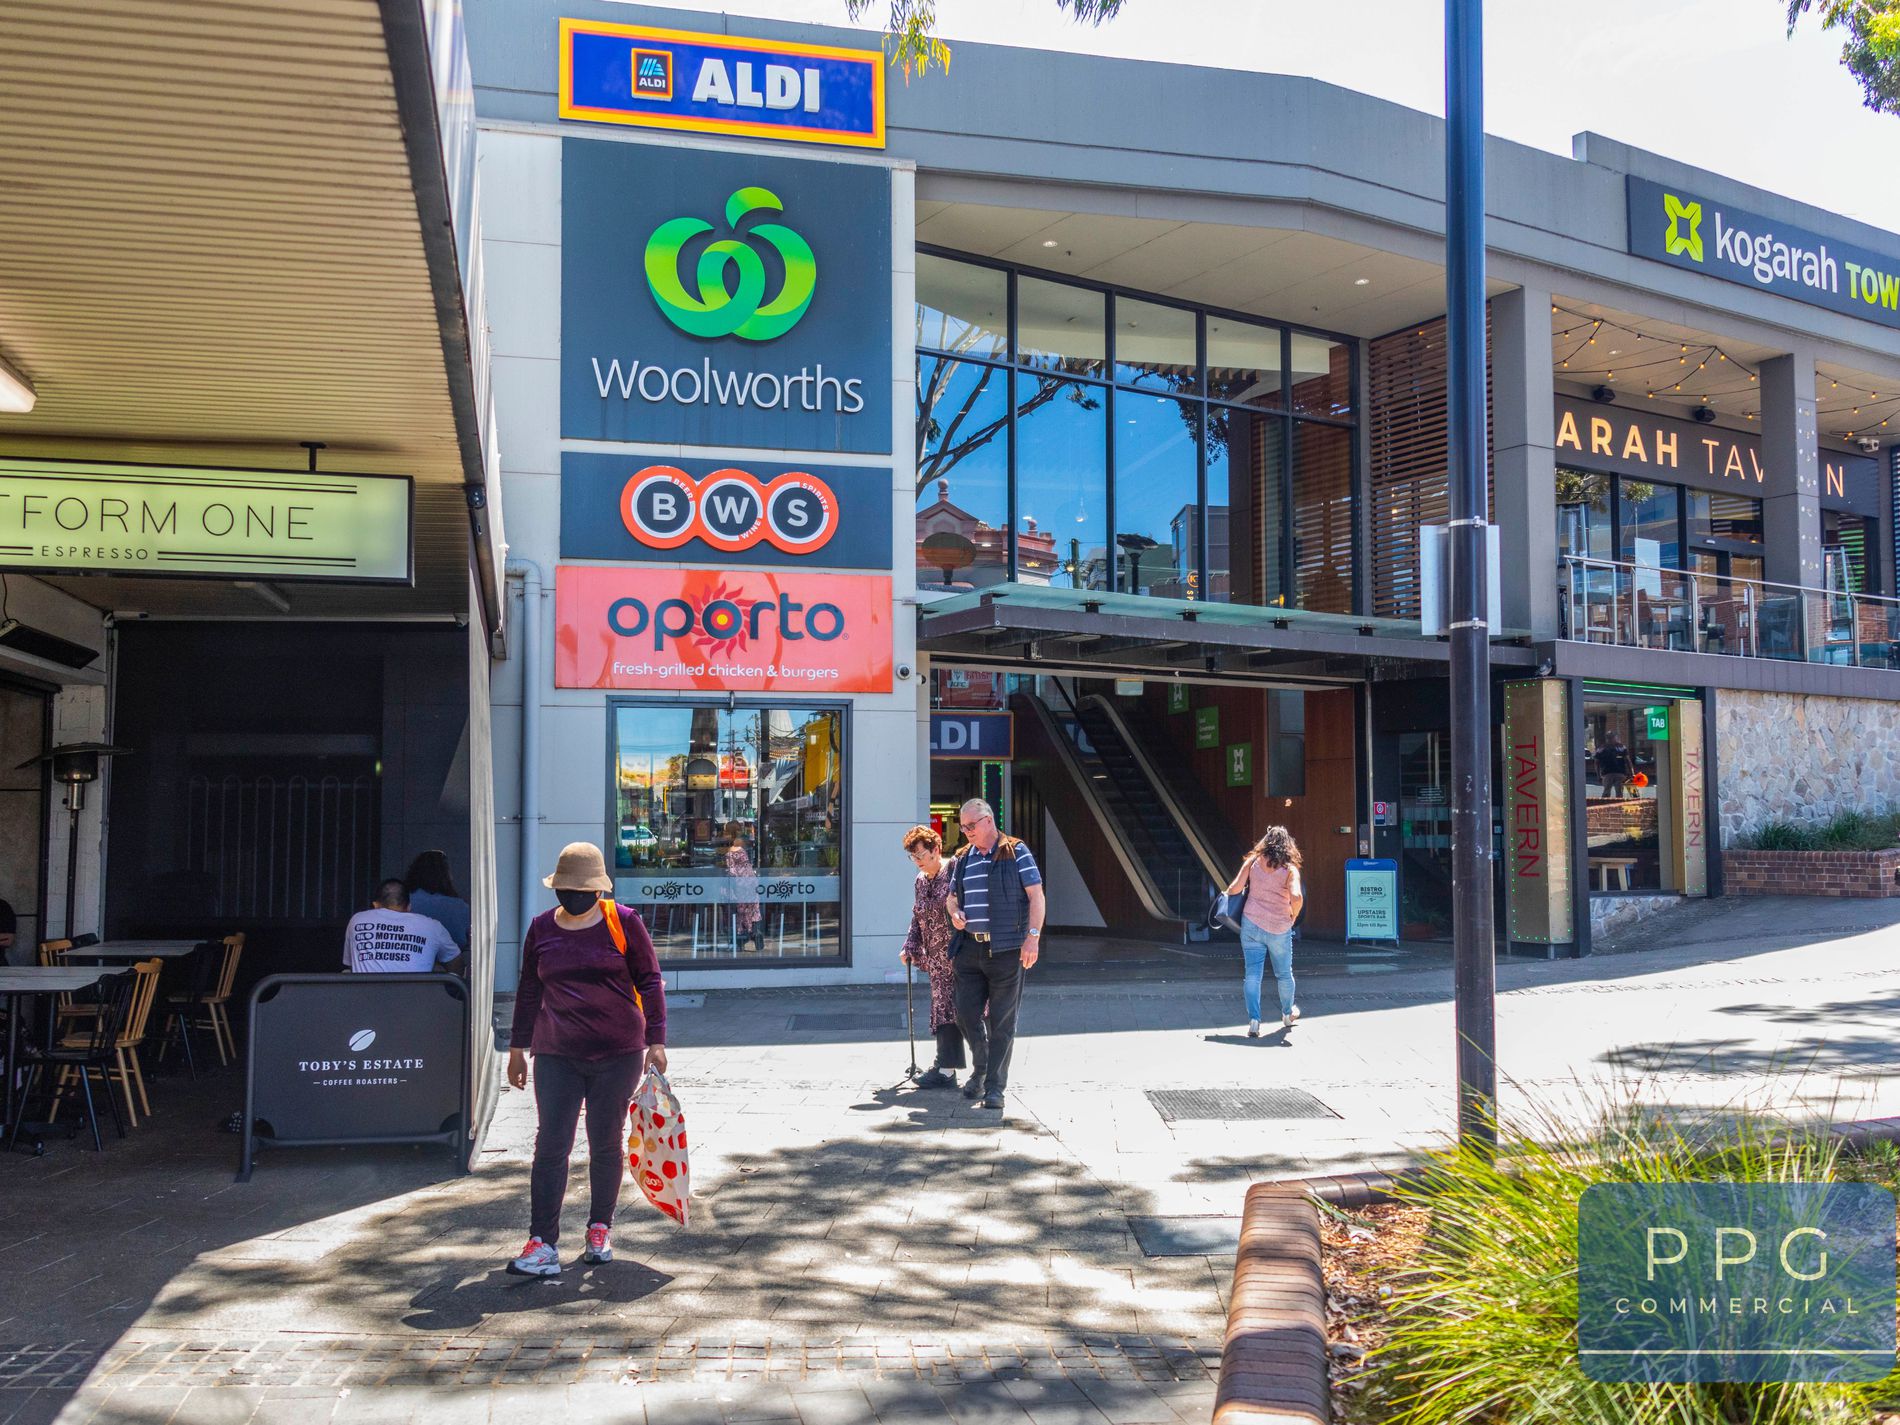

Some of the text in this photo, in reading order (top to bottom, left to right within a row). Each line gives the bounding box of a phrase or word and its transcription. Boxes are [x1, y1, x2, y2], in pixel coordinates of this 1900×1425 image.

[638, 76, 666, 89] ALDI
[692, 57, 821, 113] ALDI
[1715, 212, 1900, 311] kogarah TOW
[591, 356, 865, 413] Woolworths
[1556, 411, 1678, 468] ARAH
[673, 477, 693, 502] BEER
[801, 483, 829, 511] SPIRITS
[202, 503, 315, 540] ONE
[741, 518, 762, 539] WINE
[41, 545, 148, 560] ESPRESSO
[607, 592, 845, 651] oporto
[613, 662, 839, 681] fresh-grilled chicken & burgers
[1651, 718, 1666, 728] TAB
[1685, 747, 1701, 847] TAVERN
[1514, 736, 1541, 878] TAVERN
[642, 881, 704, 899] oporto
[756, 881, 815, 898] oporto
[376, 923, 405, 932] FOCUS
[375, 932, 427, 945] MOTIVATION
[375, 941, 423, 954] DEDICATION
[375, 952, 410, 961] EXCUSES
[298, 1058, 424, 1072] TOBY'S ESTATE
[322, 1077, 398, 1086] COFFEE ROASTERS
